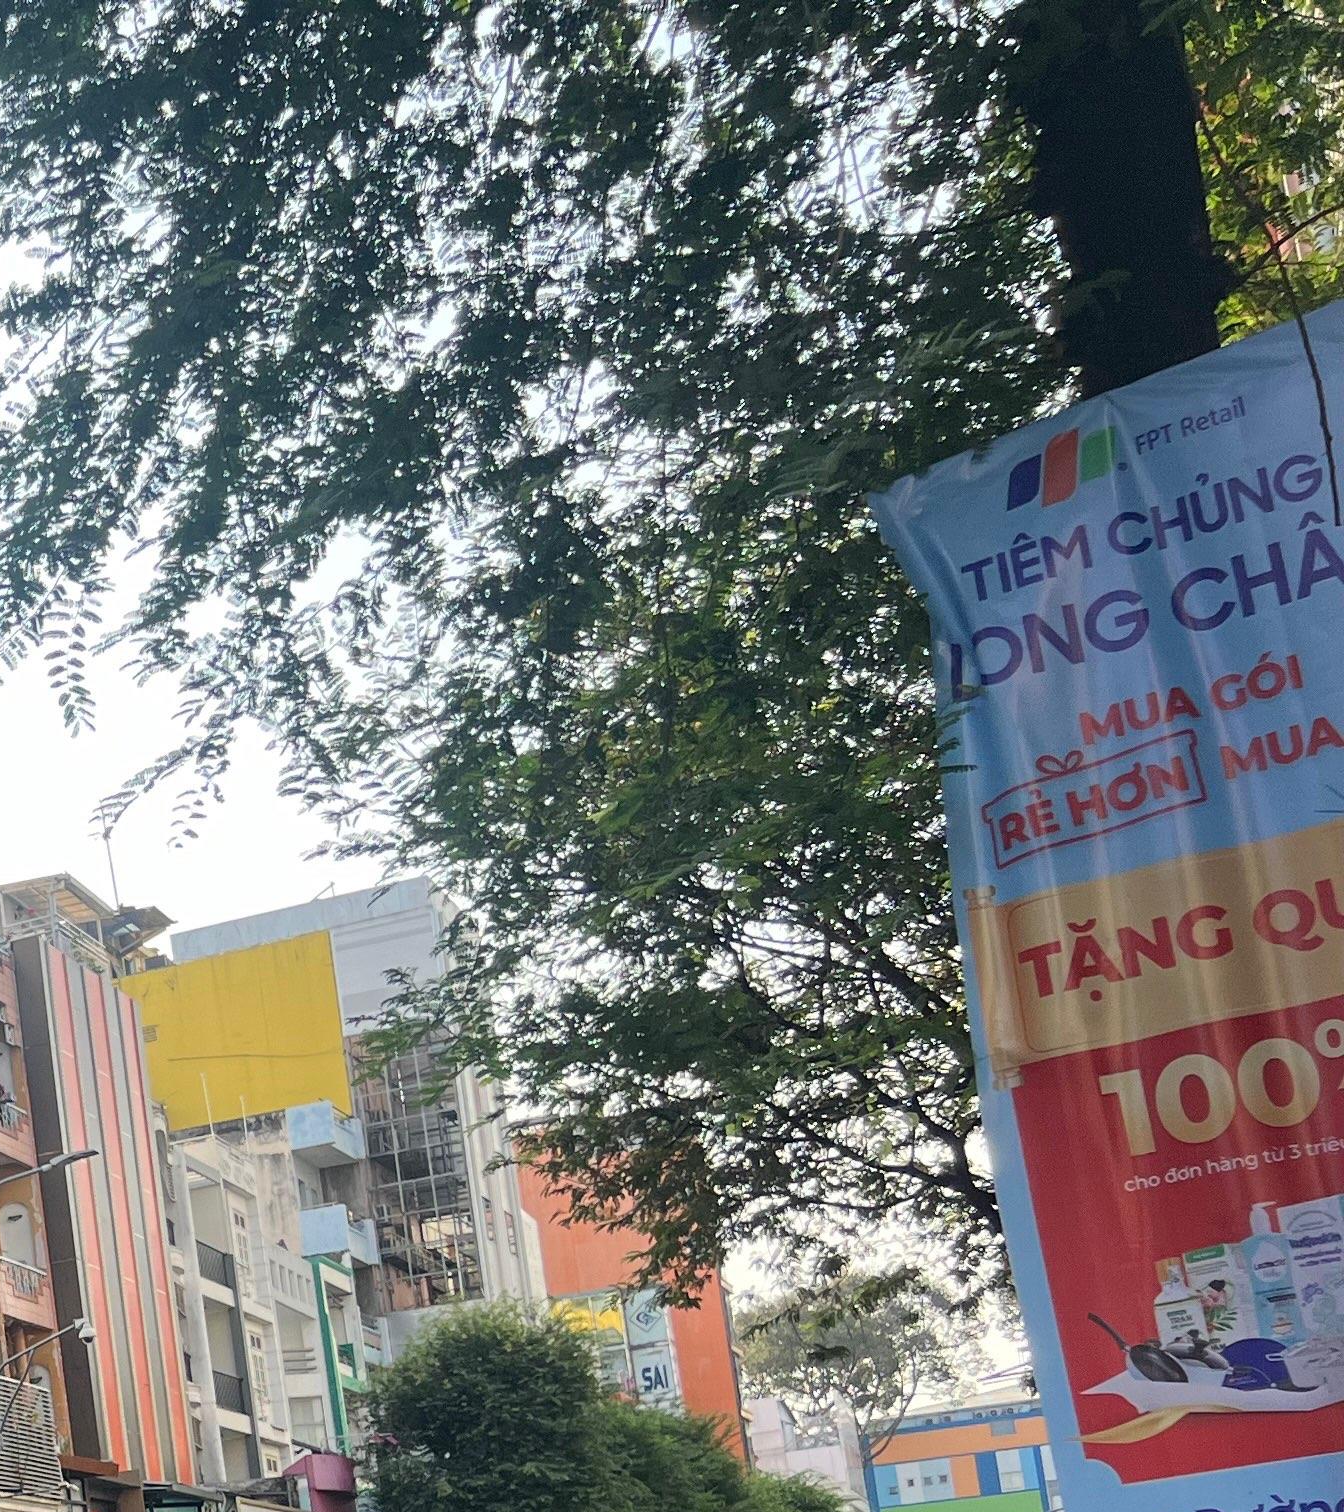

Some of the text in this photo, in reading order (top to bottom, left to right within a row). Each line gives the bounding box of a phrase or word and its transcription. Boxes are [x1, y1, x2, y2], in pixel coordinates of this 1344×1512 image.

[1134, 396, 1247, 455] FPT Retail
[962, 454, 1323, 602] TIÊM CHỦNG
[1079, 651, 1304, 746] MUA GÓI
[998, 716, 1344, 850] RẺ HƠN MUA
[1018, 905, 1234, 1002] TẶNG
[1123, 1173, 1161, 1194] cho
[1164, 1163, 1203, 1185] đơn
[1206, 1153, 1260, 1176] hàng
[1262, 1144, 1285, 1164] từ
[1288, 1142, 1303, 1160] 3
